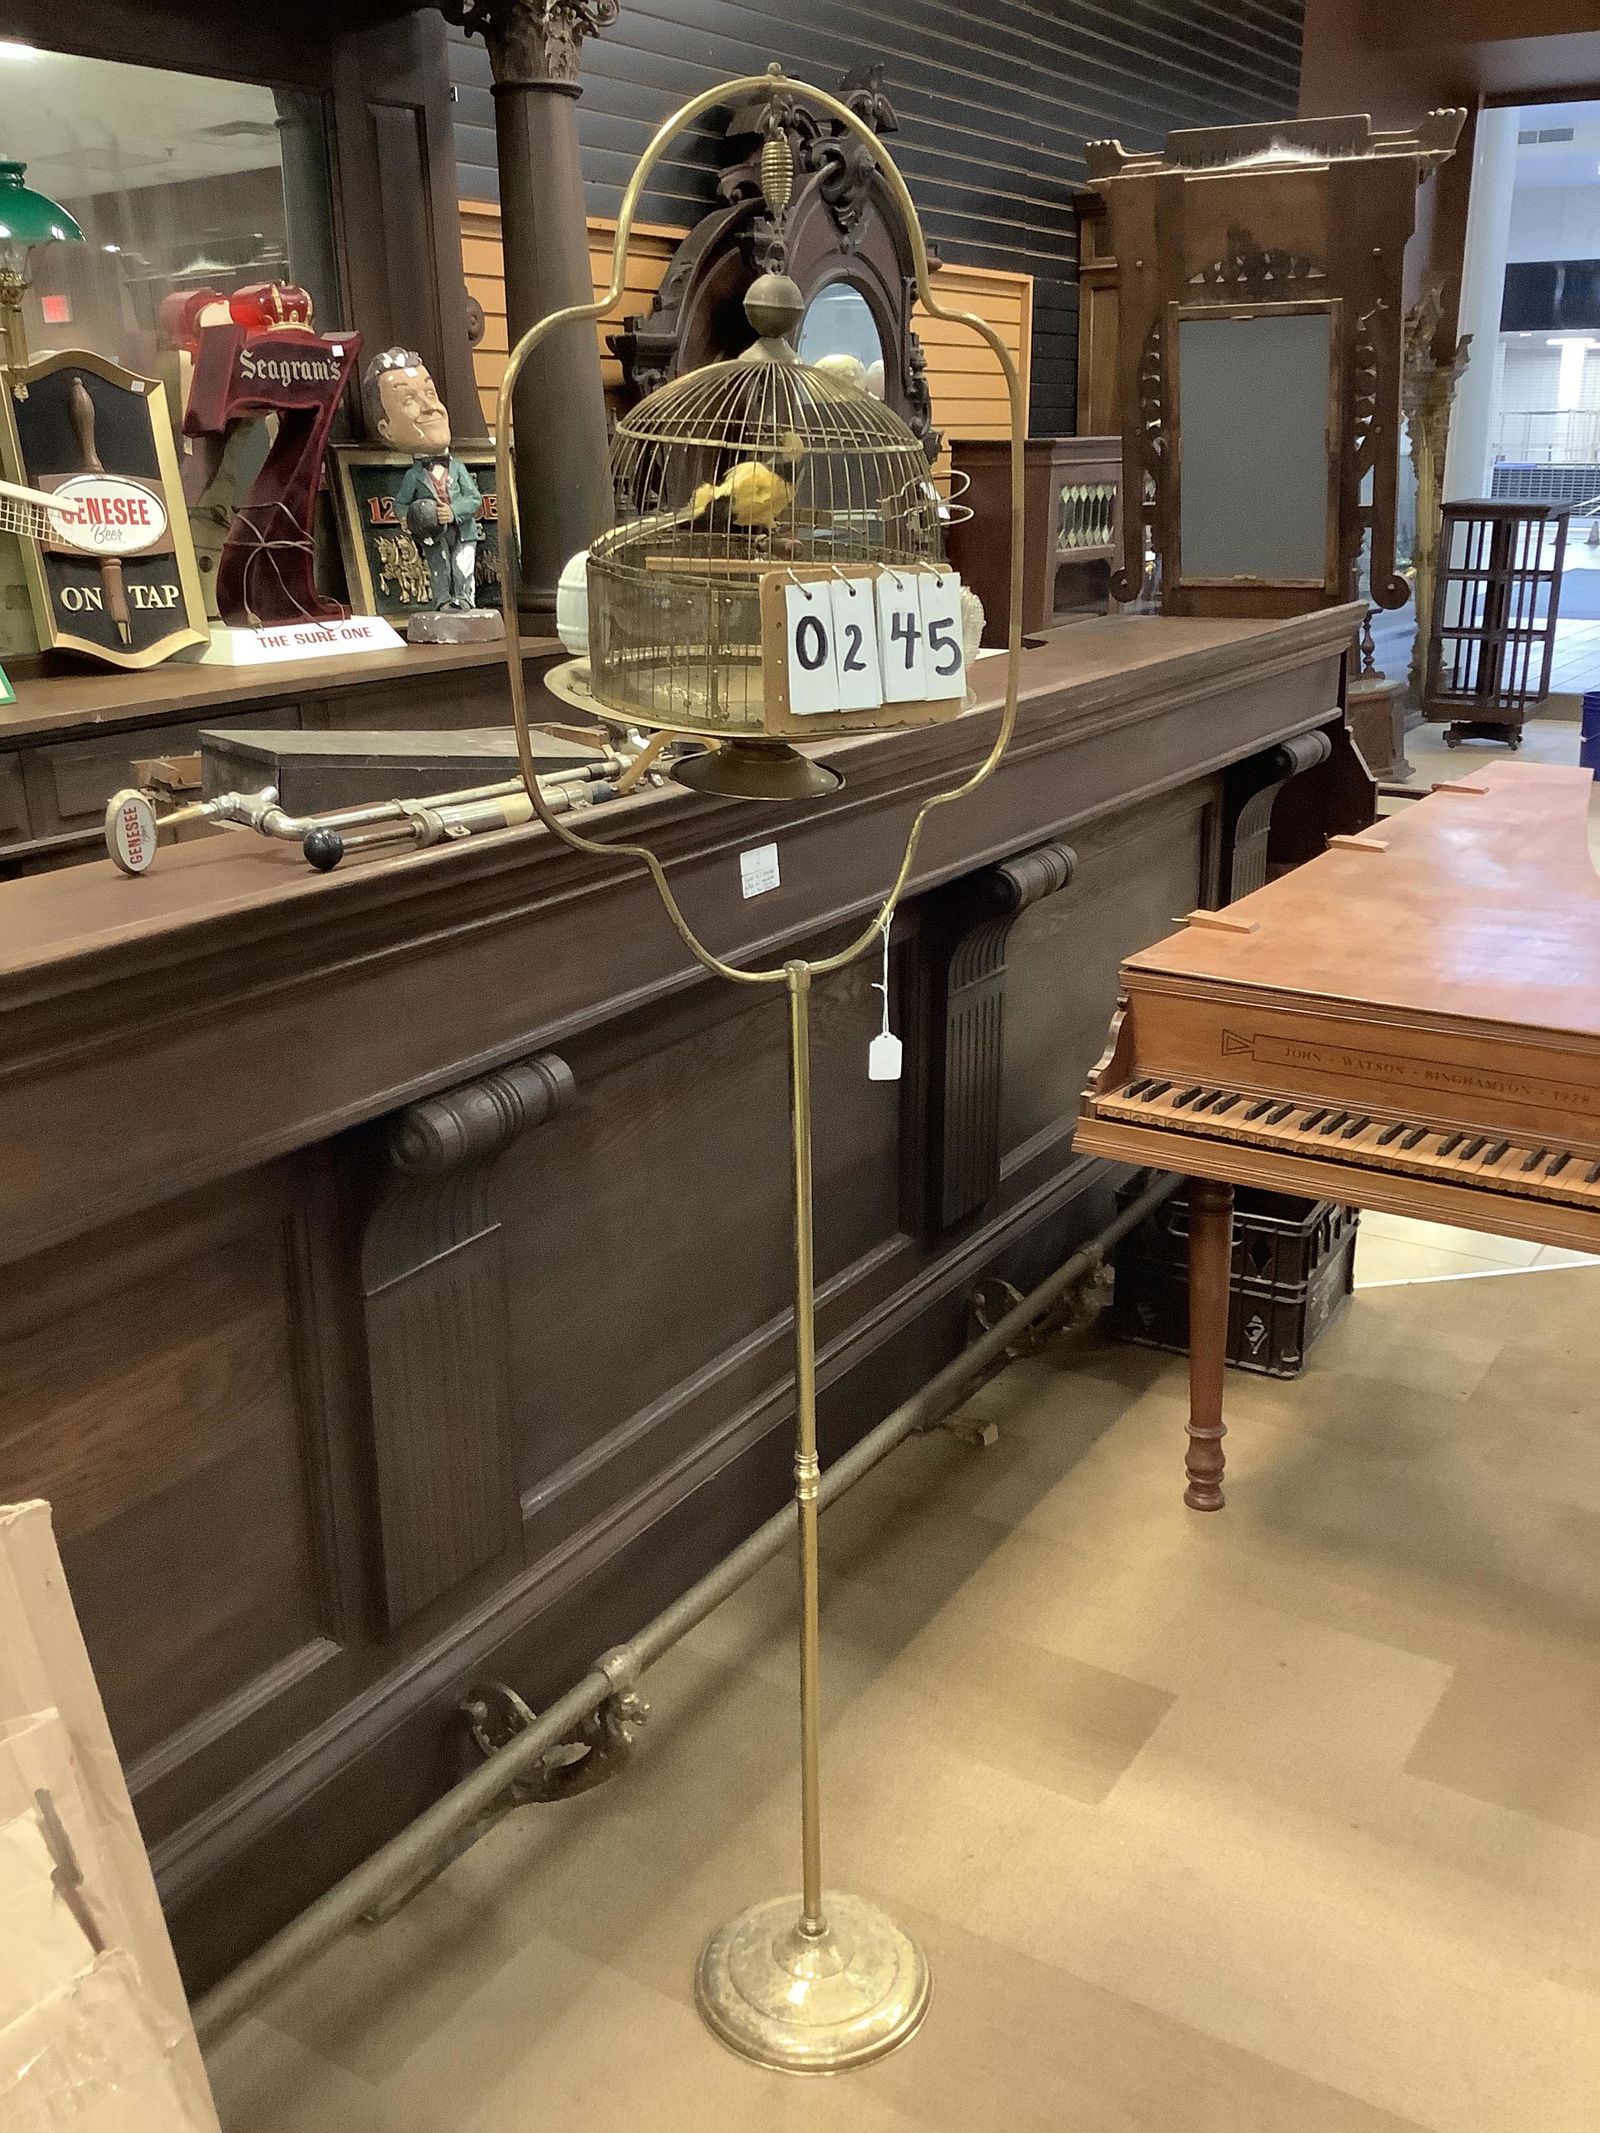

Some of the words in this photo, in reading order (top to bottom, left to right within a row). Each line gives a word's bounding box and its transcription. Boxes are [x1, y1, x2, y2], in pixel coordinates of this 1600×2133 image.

[240, 349, 342, 388] Seagram's
[367, 496, 401, 524] 12
[90, 522, 123, 544] Beer
[61, 587, 103, 611] ON
[128, 585, 180, 609] TAP
[257, 635, 290, 648] THE
[294, 629, 337, 645] SURE
[341, 627, 373, 640] ONE
[123, 806, 143, 865] GENESEE
[1284, 1049, 1321, 1062] JOHN
[1342, 1056, 1405, 1075] WATSON
[1424, 1070, 1531, 1095] BINGHAMTON
